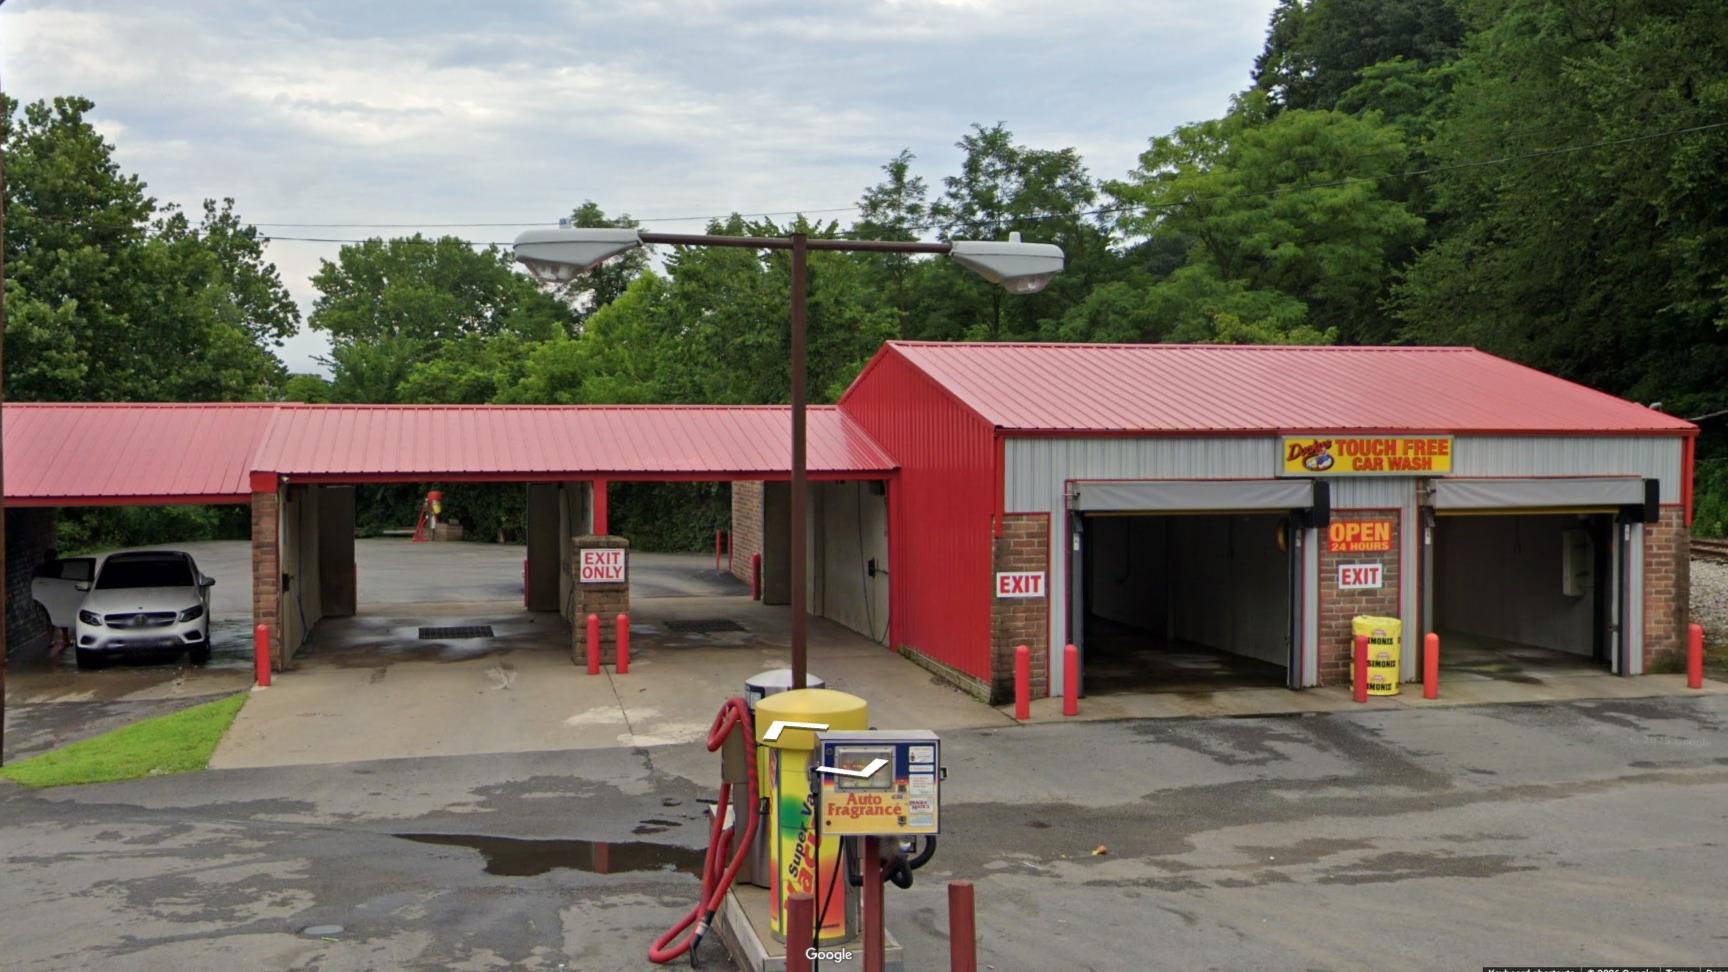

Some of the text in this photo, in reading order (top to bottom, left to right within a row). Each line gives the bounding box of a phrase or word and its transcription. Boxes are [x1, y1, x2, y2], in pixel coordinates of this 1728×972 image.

[1335, 439, 1397, 456] TOUCH
[1402, 439, 1449, 456] FREE
[1352, 457, 1432, 471] CAR WASH
[1330, 522, 1390, 542] OPEN
[1331, 541, 1390, 552] 24 HOURS
[584, 552, 621, 565] EXIT
[582, 566, 622, 579] ONLY
[1342, 567, 1379, 585] EXIT
[1000, 575, 1041, 593] EXIT
[1368, 637, 1393, 646] IMONIZ
[846, 792, 882, 806] Auto
[827, 803, 903, 819] Fragrance
[788, 821, 808, 878] Super
